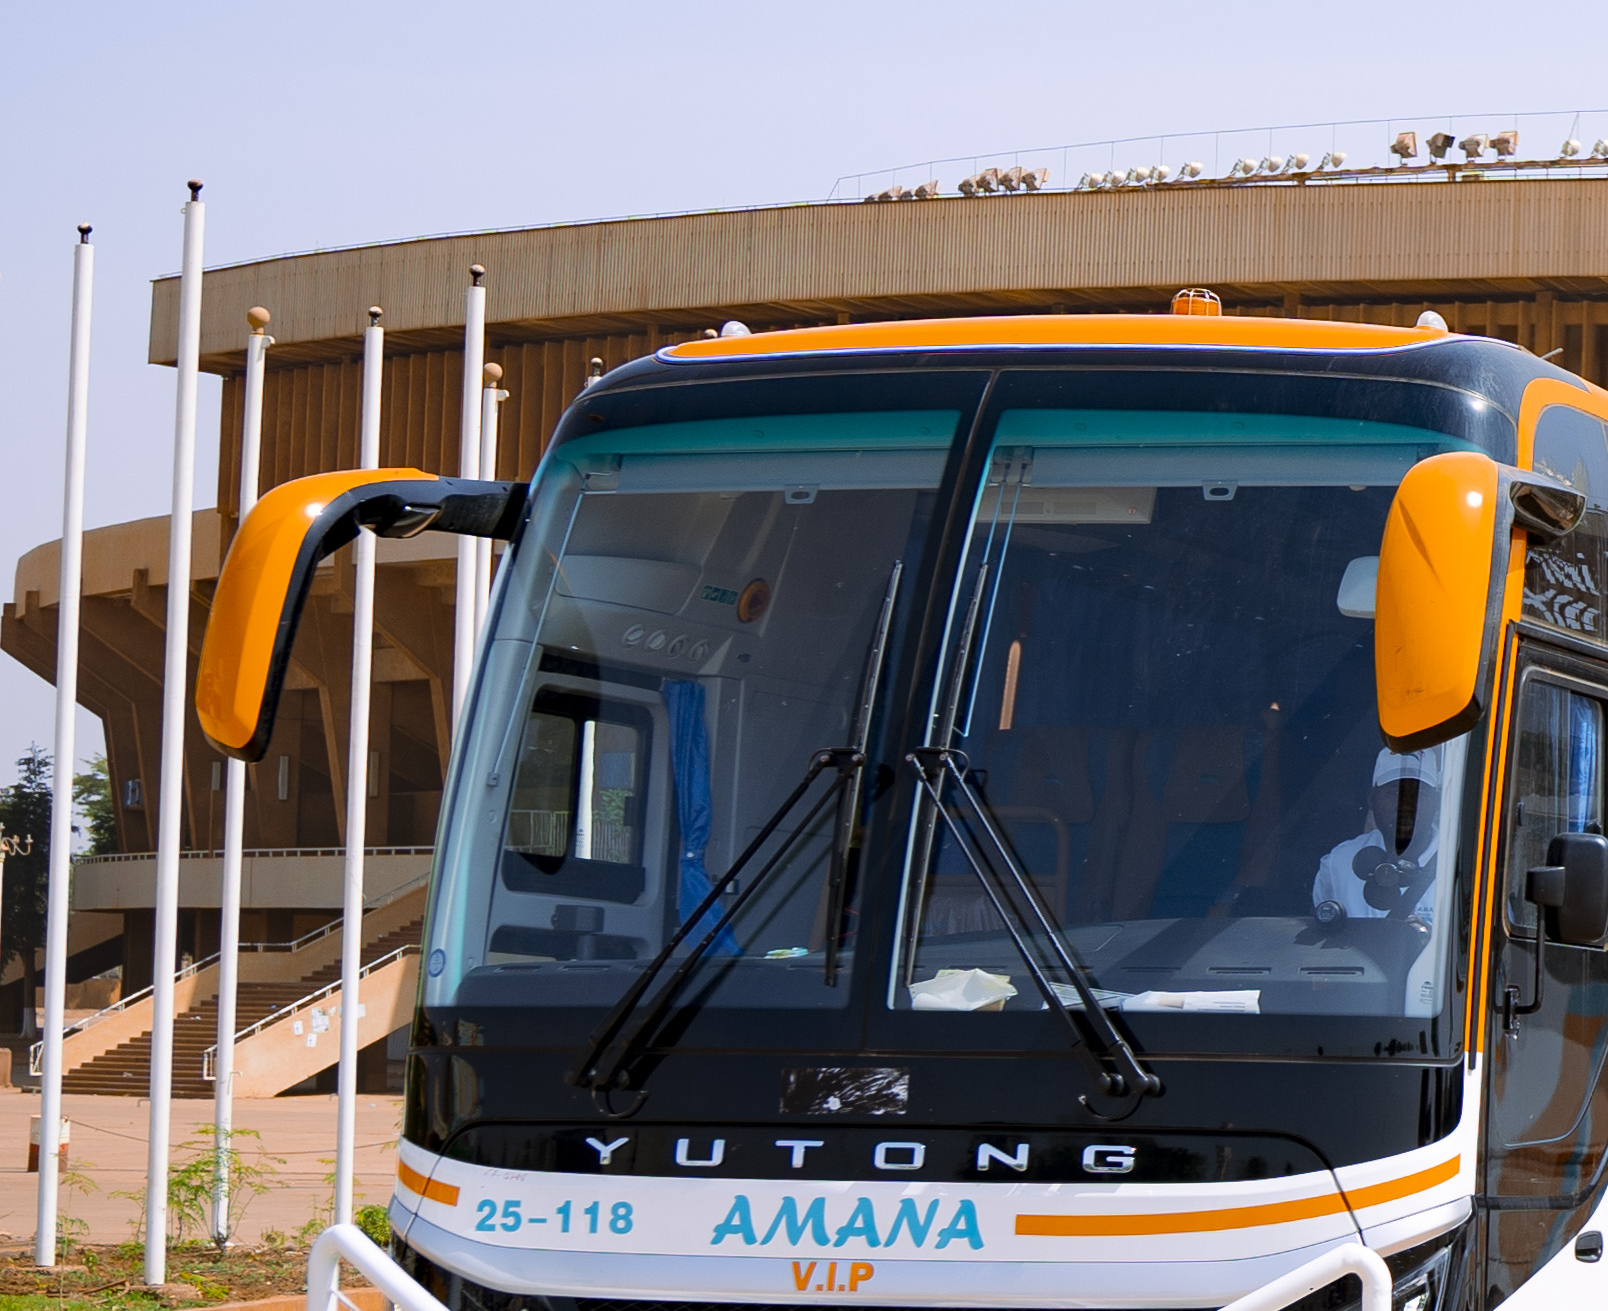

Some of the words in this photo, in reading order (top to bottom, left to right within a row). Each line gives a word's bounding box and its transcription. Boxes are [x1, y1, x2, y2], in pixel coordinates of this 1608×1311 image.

[584, 1136, 1139, 1175] YUTONG
[475, 1199, 635, 1235] 25-118
[710, 1194, 986, 1251] AMANA
[792, 1262, 875, 1294] V.I.P
